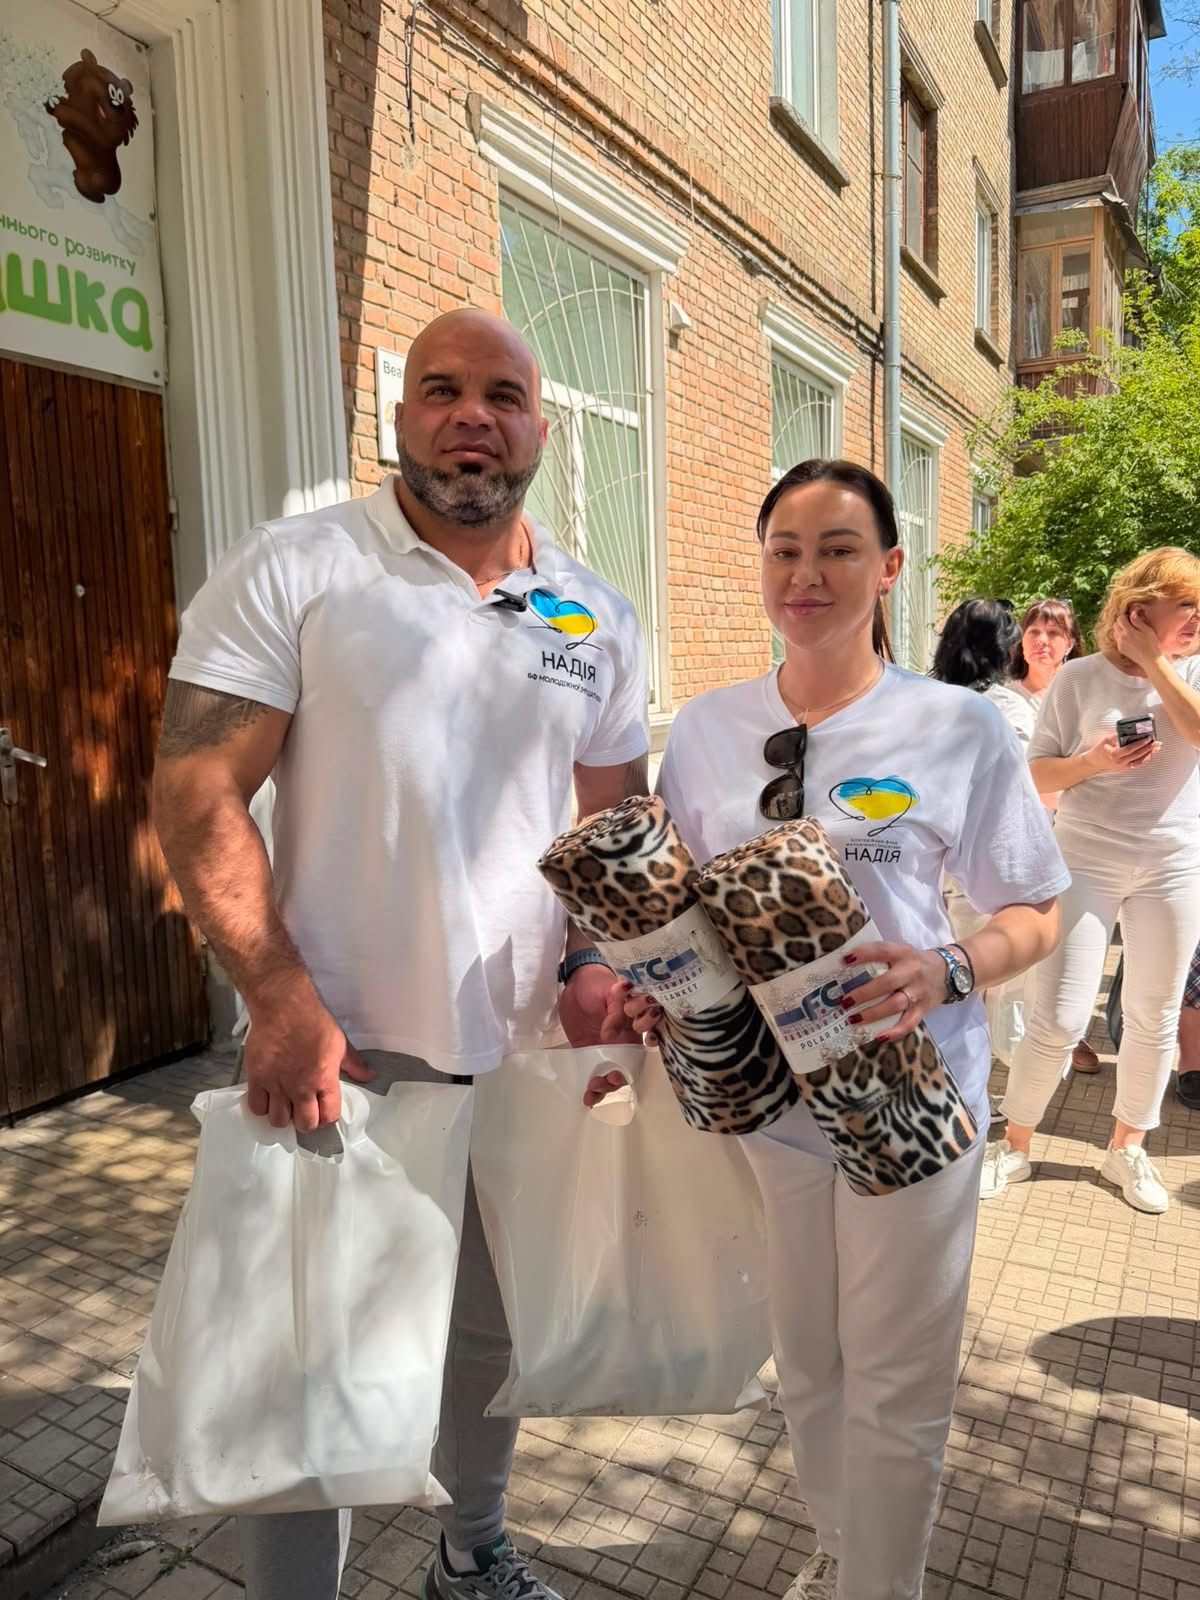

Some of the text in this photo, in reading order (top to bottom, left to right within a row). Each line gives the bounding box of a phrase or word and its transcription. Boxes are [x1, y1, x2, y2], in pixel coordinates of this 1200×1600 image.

[65, 237, 136, 276] розвитку
[0, 252, 153, 352] шка
[541, 650, 597, 684] НАДІЯ
[844, 847, 901, 863] НАДІЯ
[800, 1031, 831, 1050] POLAR
